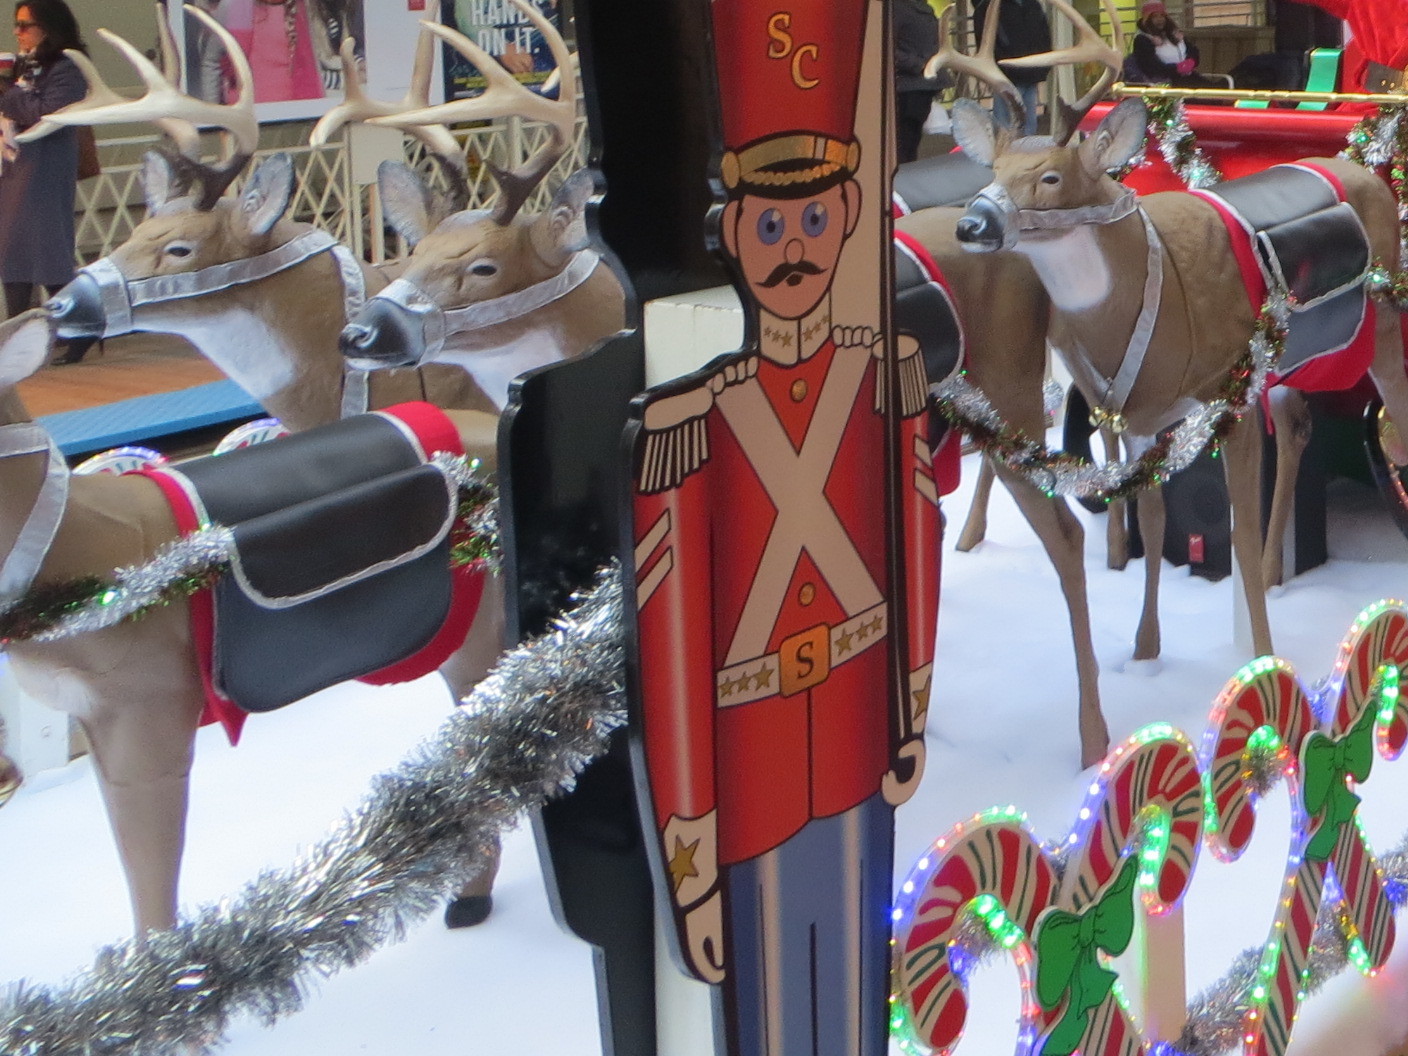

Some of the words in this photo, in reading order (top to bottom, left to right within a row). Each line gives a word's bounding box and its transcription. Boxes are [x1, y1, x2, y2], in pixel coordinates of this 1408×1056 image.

[478, 27, 508, 56] ON
[515, 26, 541, 54] IT.
[795, 641, 815, 680] S
